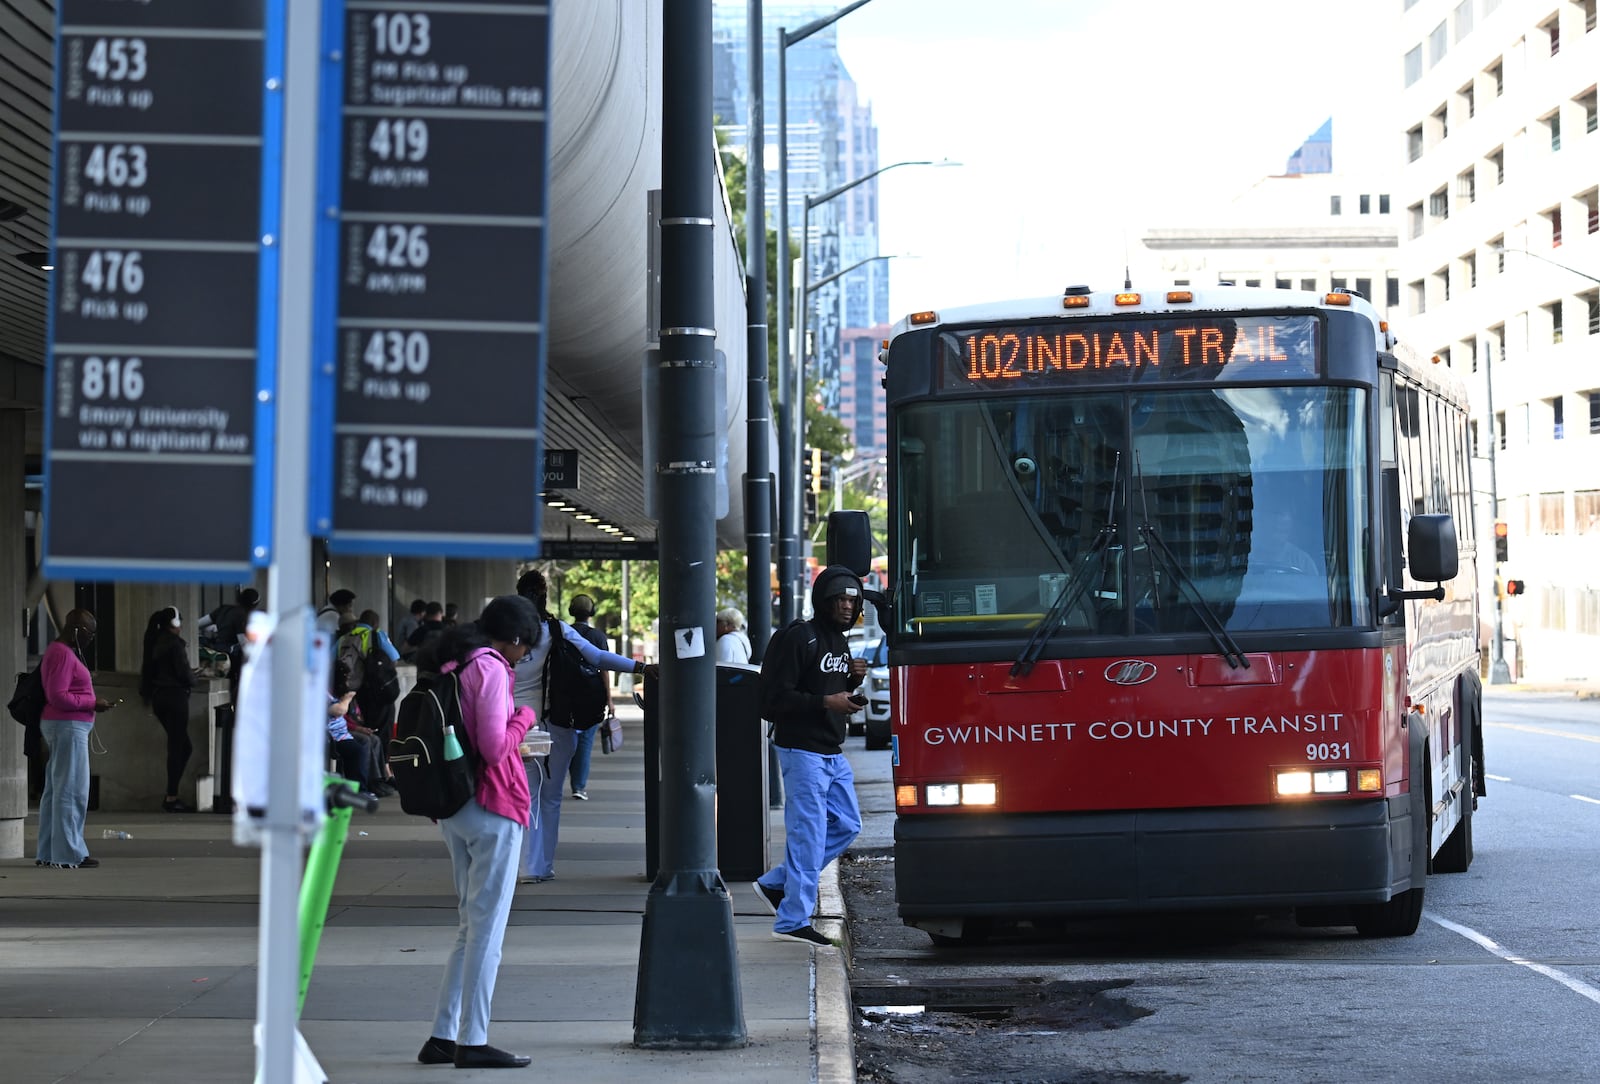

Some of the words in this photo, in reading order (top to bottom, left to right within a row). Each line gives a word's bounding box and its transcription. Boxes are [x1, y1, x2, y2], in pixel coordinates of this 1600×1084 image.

[372, 13, 430, 55] 103
[88, 39, 146, 80] 453
[402, 62, 438, 80] Pick
[444, 66, 467, 85] up
[87, 87, 123, 105] Pick
[129, 90, 153, 110] up
[370, 120, 428, 161] 419
[85, 145, 147, 187] 463
[85, 193, 121, 211] Pick
[126, 197, 150, 216] up
[368, 225, 429, 267] 426
[83, 251, 143, 293] 476
[82, 299, 118, 318] Pick
[123, 303, 147, 322] up
[365, 331, 429, 373] 430
[967, 334, 1021, 378] 102
[1027, 331, 1159, 371] INDIAN
[1175, 325, 1288, 365] TRAIL
[82, 356, 144, 400] 816
[364, 379, 400, 398] Pick
[405, 383, 430, 402] up
[80, 405, 135, 428] Emory
[138, 407, 228, 430] University
[112, 431, 126, 447] N
[130, 430, 210, 453] Highland
[215, 432, 248, 450] Ave
[362, 437, 416, 479] 431
[541, 470, 563, 484] you
[362, 485, 398, 504] Pick
[403, 489, 427, 508] up
[924, 723, 1076, 745] GWINNETT
[1089, 719, 1213, 739] COUNTY
[1226, 714, 1343, 734] TRANSIT
[1306, 742, 1349, 760] 9031
